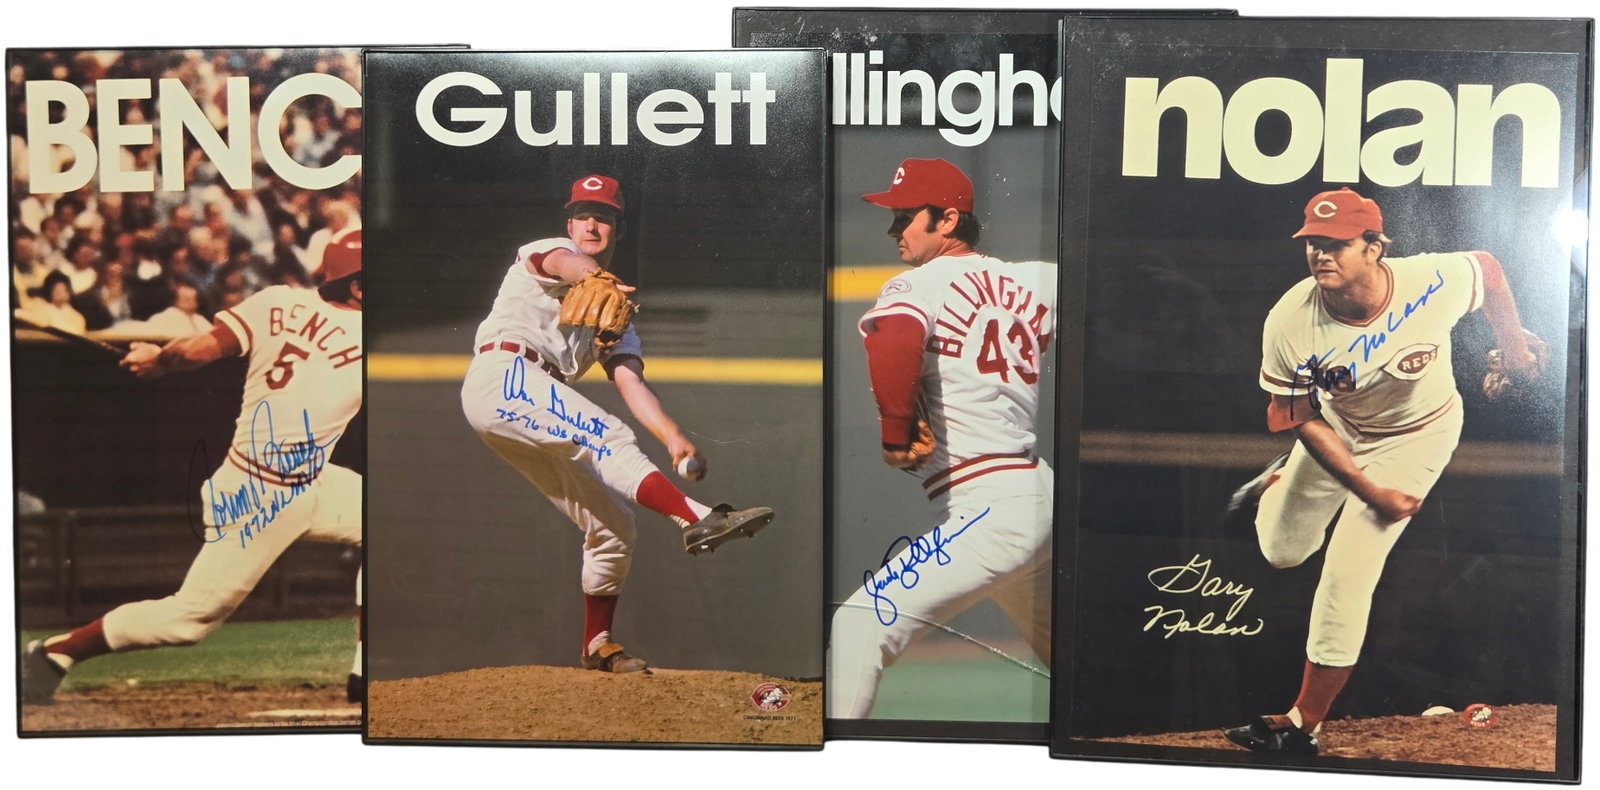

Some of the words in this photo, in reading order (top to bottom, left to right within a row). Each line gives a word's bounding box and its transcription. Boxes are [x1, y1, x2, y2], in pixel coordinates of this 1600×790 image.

[415, 71, 776, 147] Gullett
[832, 50, 1062, 147] llingh
[1122, 58, 1561, 187] nolan
[25, 72, 362, 194] BENC
[582, 177, 603, 191] C
[1313, 200, 1338, 218] C
[264, 341, 311, 391] 5
[270, 306, 363, 370] BENCH
[976, 318, 1039, 385] 43
[1401, 349, 1438, 372] REDS
[1147, 553, 1254, 622] Gary
[1143, 605, 1265, 640] Nolan
